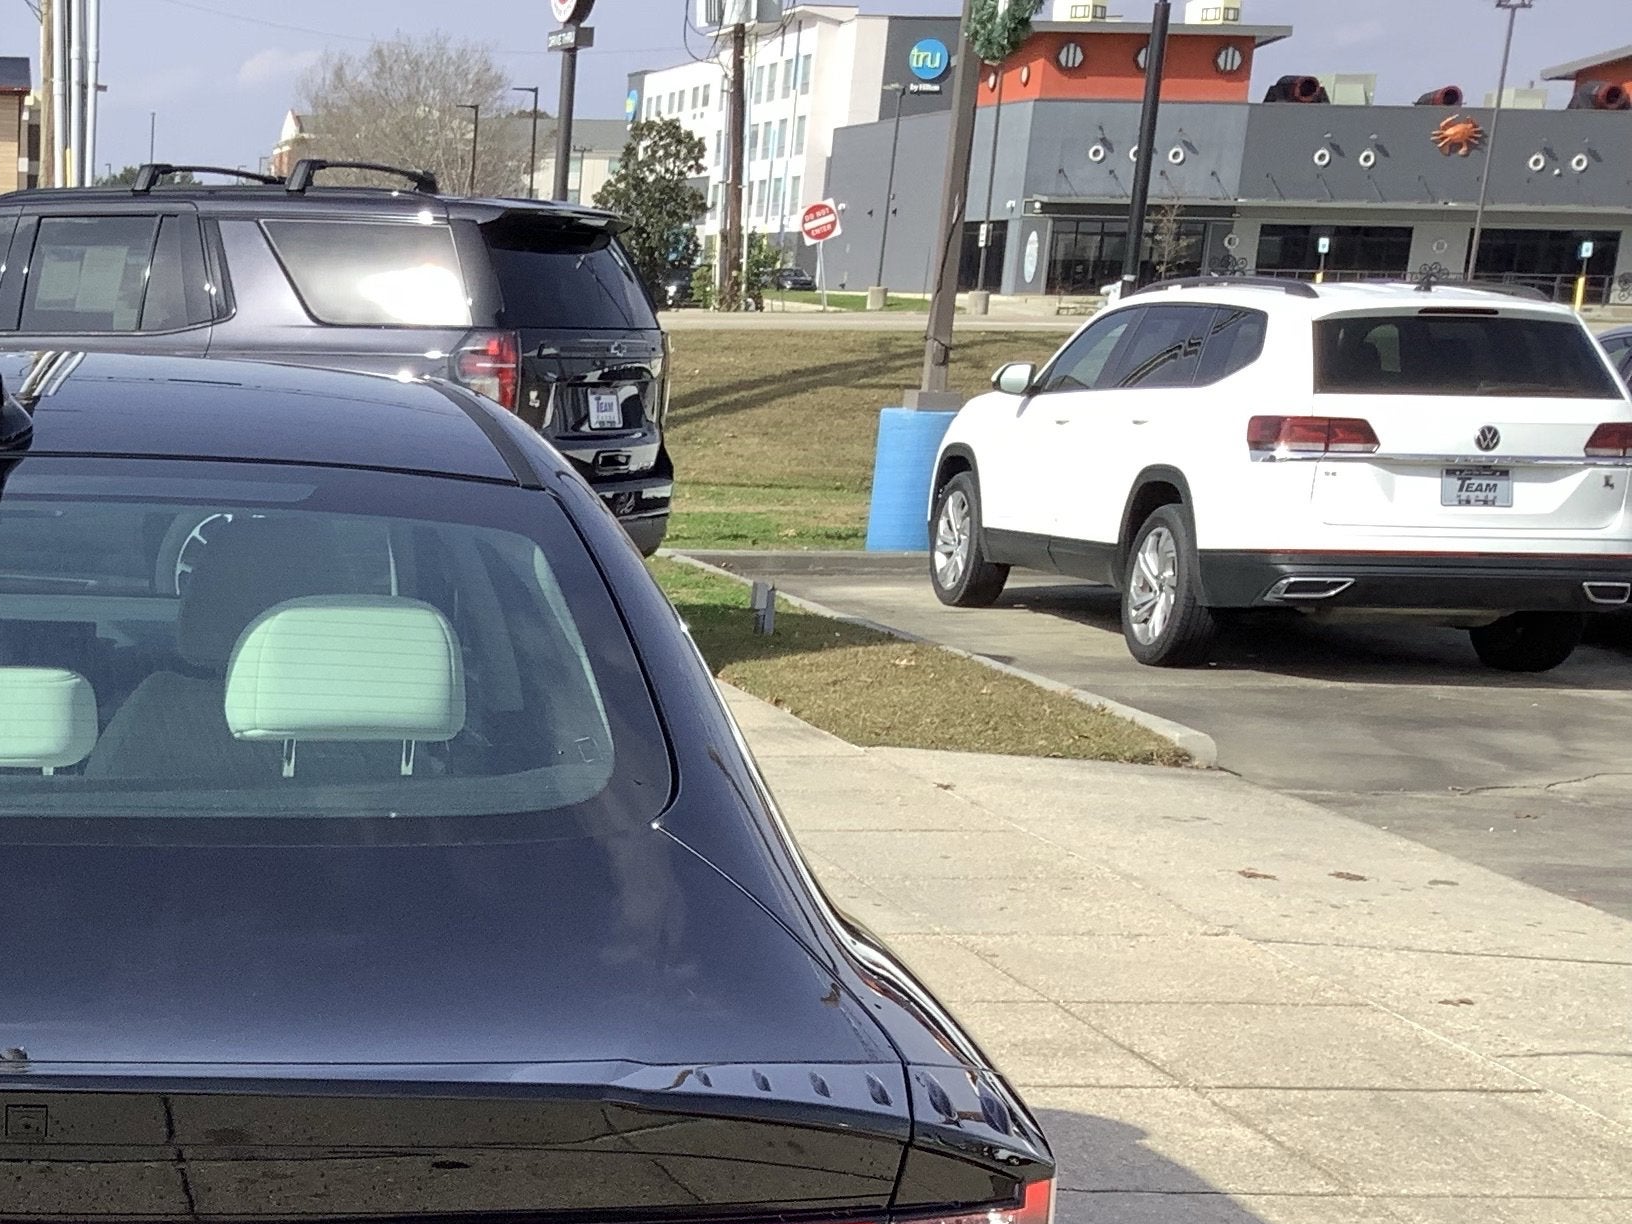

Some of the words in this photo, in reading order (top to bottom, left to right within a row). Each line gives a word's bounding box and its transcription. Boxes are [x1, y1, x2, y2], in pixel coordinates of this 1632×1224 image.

[912, 47, 942, 69] tru
[804, 212, 815, 222] DO
[815, 206, 830, 218] NOT
[811, 223, 832, 236] ENTER
